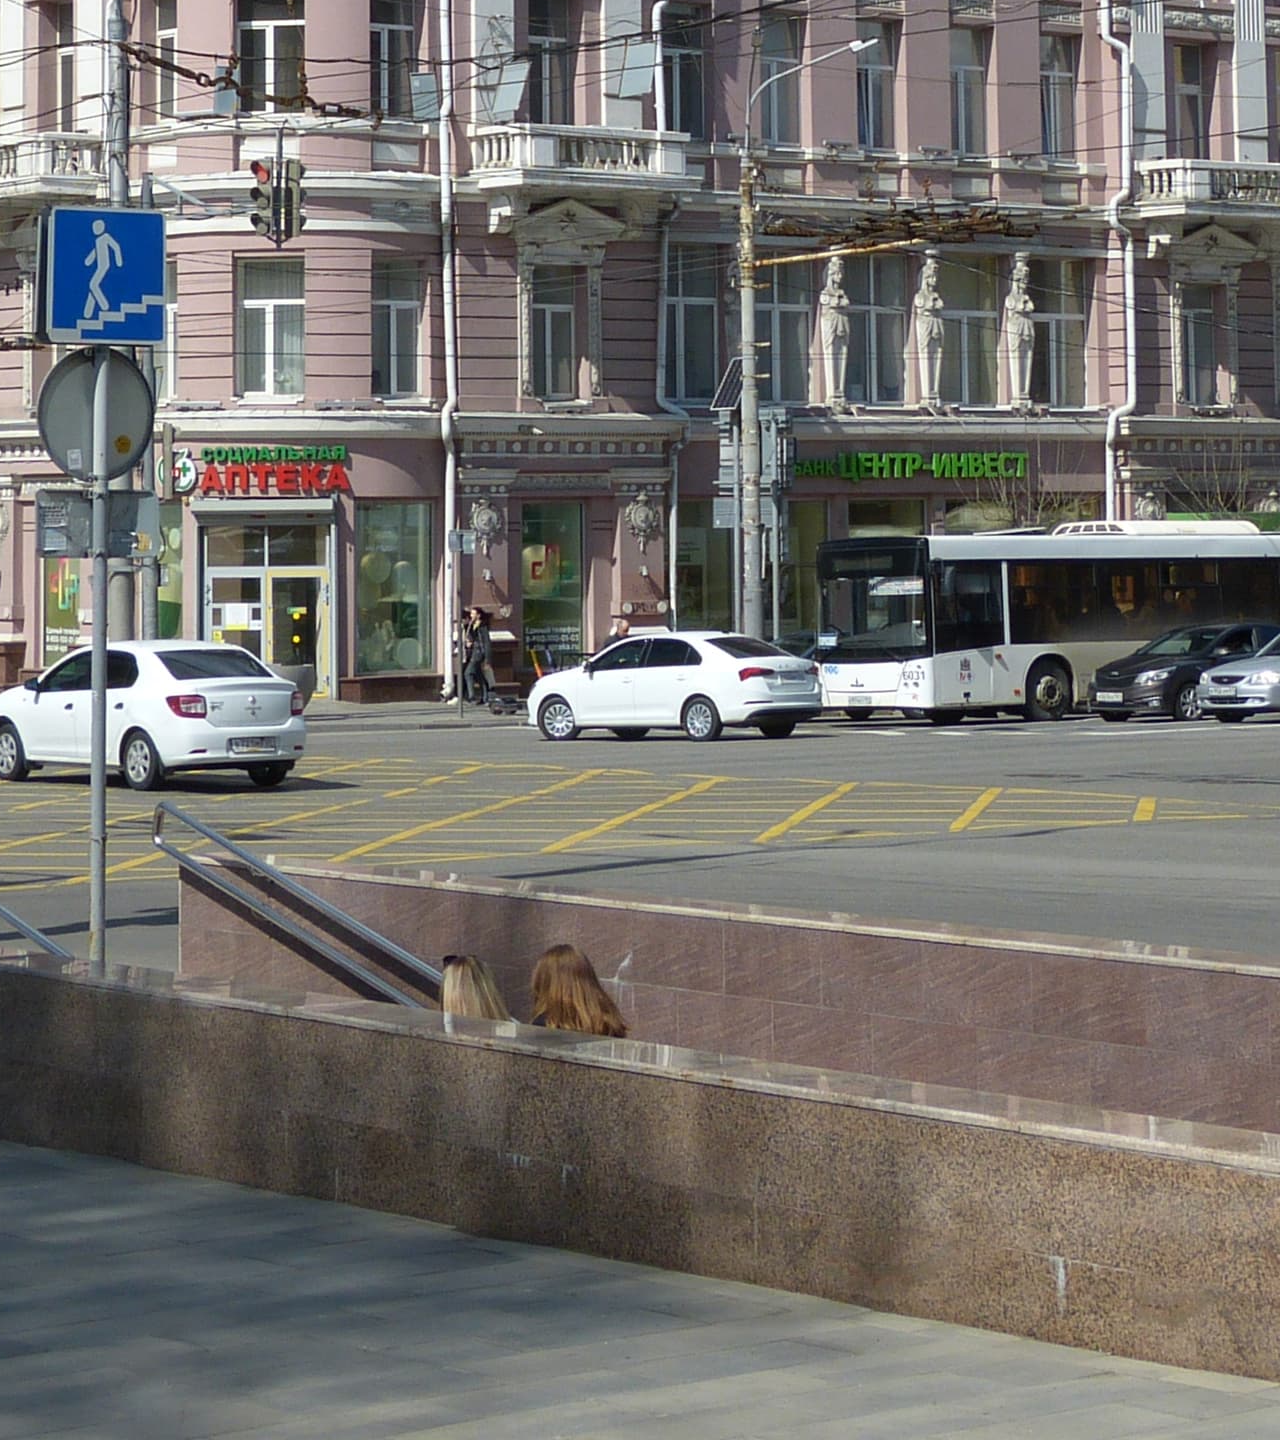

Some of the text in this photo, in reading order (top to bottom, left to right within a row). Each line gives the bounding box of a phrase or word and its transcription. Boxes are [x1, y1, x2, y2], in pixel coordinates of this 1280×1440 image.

[201, 445, 347, 462] СОЦИАЛЬНАЯ
[793, 452, 1028, 482] БАНК ЦЕНТР-ИНВЕСТ
[201, 463, 349, 491] АПТЕКА
